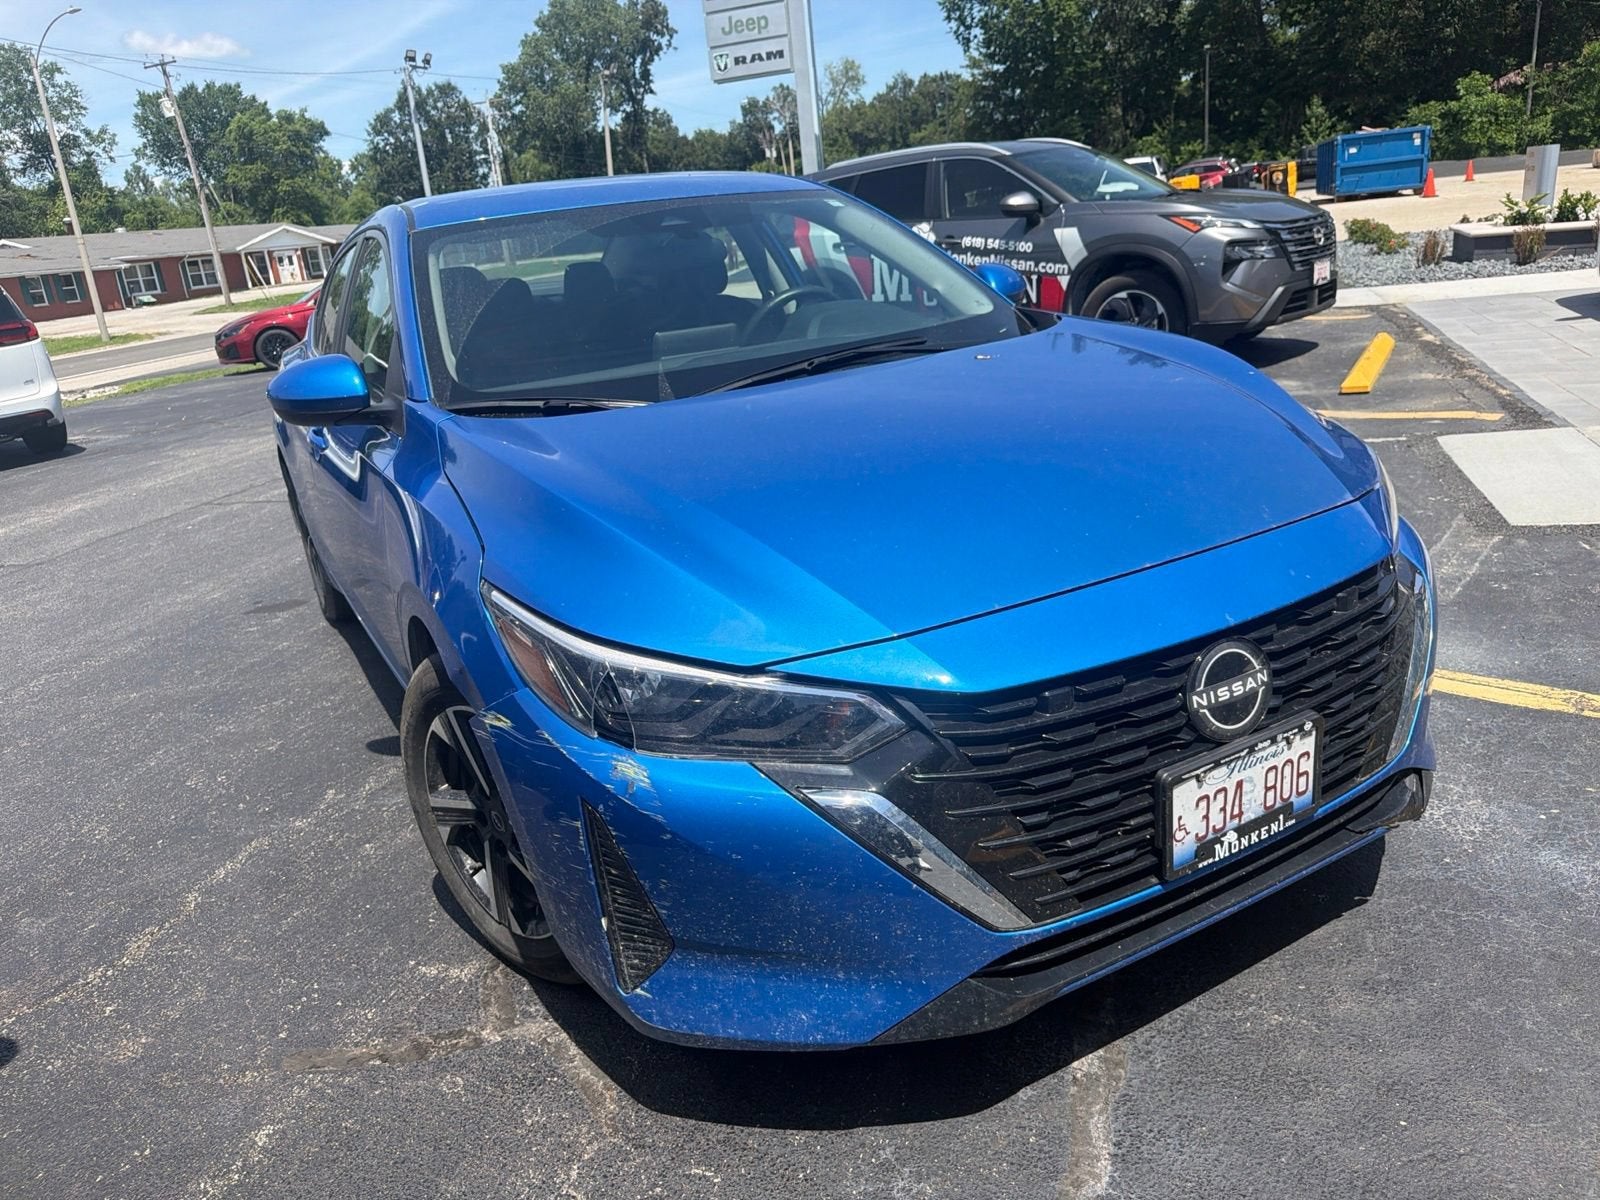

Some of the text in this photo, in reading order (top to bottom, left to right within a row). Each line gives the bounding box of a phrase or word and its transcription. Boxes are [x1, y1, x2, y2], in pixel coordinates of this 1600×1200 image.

[721, 14, 769, 36] Jeep
[734, 49, 785, 66] RAM
[961, 236, 1033, 253] (618) 545-5100
[1192, 669, 1267, 708] NISSAN
[1213, 741, 1286, 782] Illinois
[1195, 751, 1310, 842] 334 806
